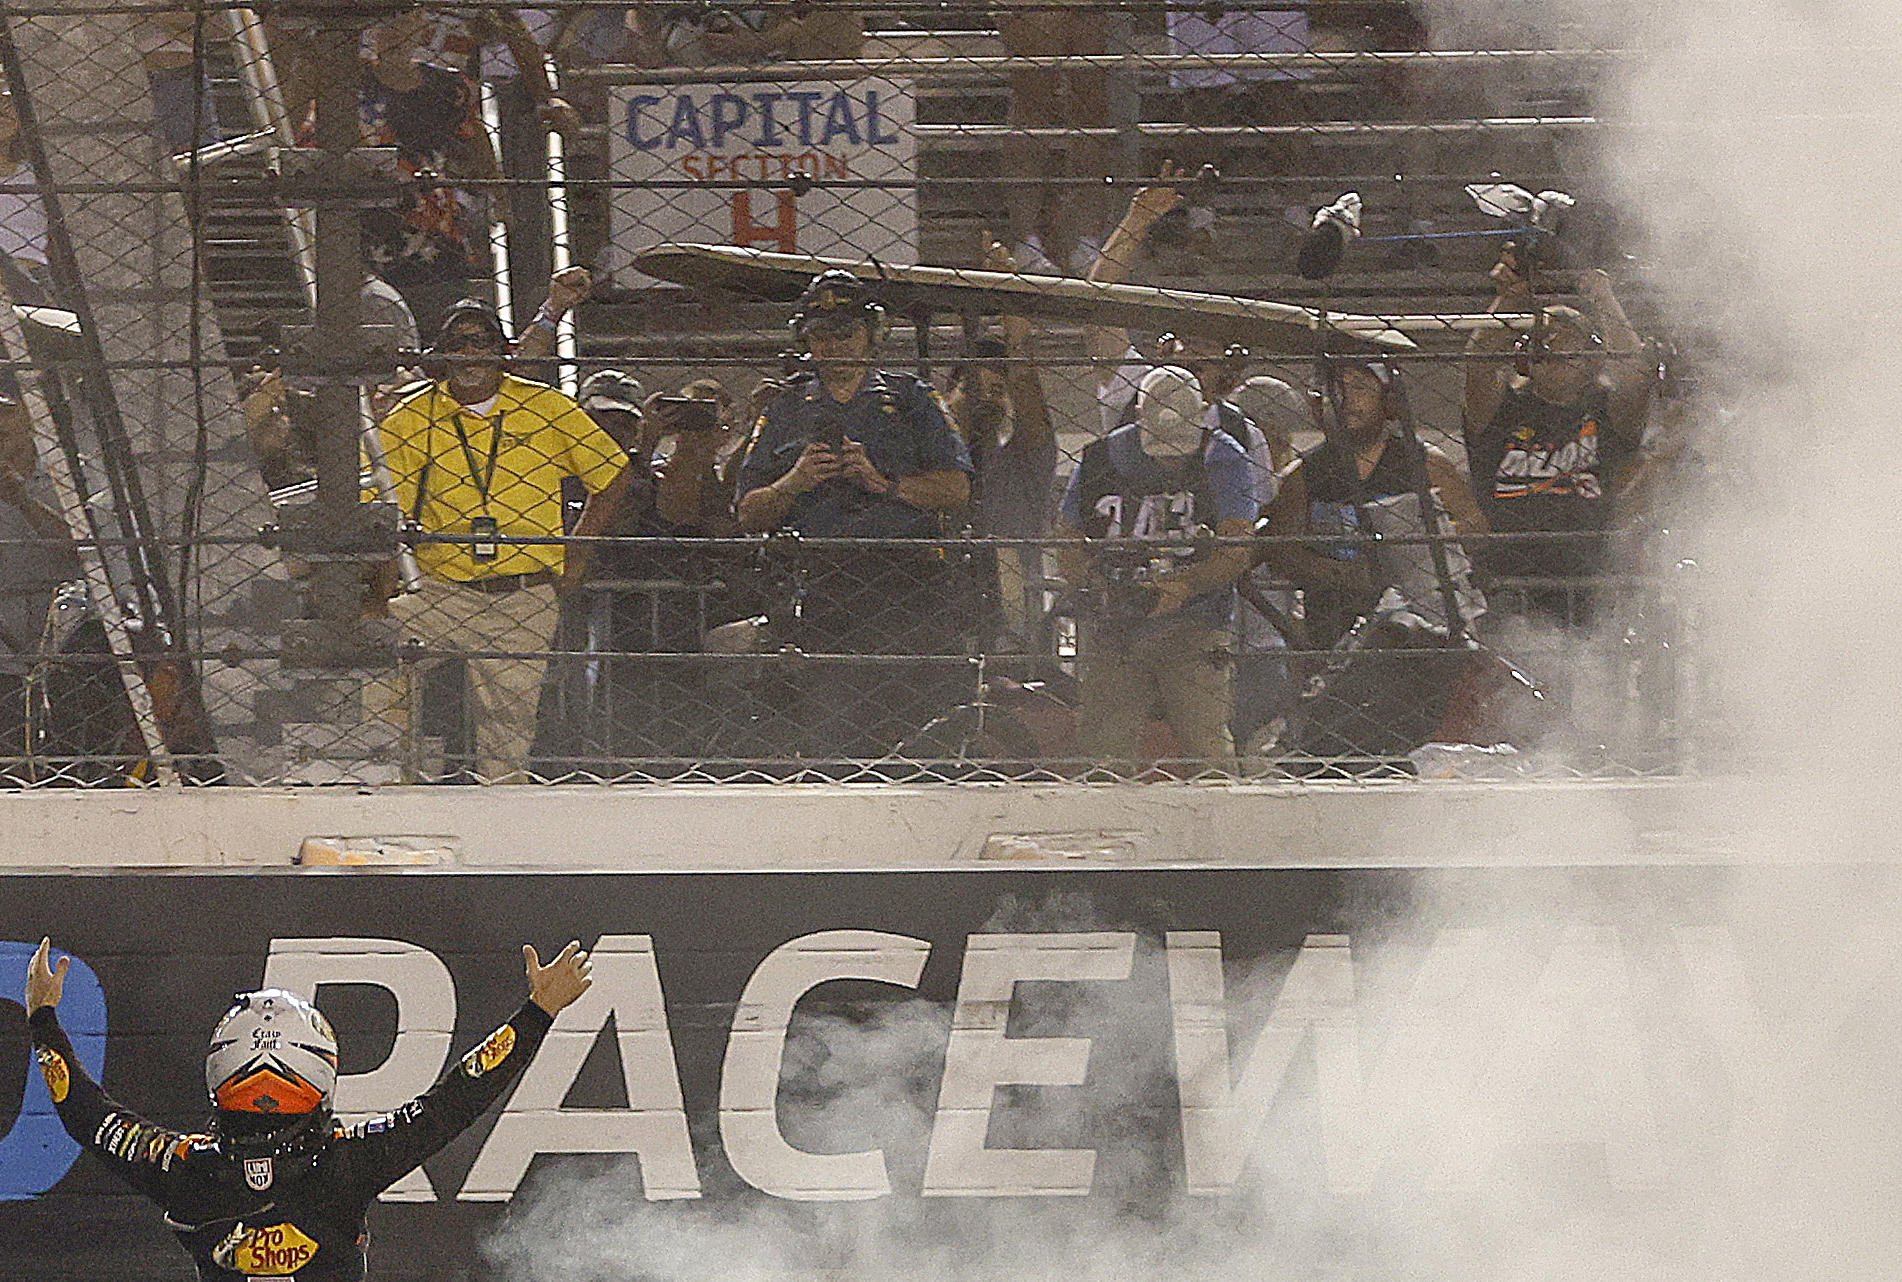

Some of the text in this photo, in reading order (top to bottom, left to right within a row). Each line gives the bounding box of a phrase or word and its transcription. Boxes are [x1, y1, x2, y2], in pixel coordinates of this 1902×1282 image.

[627, 90, 899, 149] CAPITAL
[682, 153, 847, 181] SECTION
[731, 191, 797, 253] H
[250, 929, 1902, 1204] RACEWA
[248, 1229, 285, 1249] Pro
[251, 1244, 311, 1269] Shops
